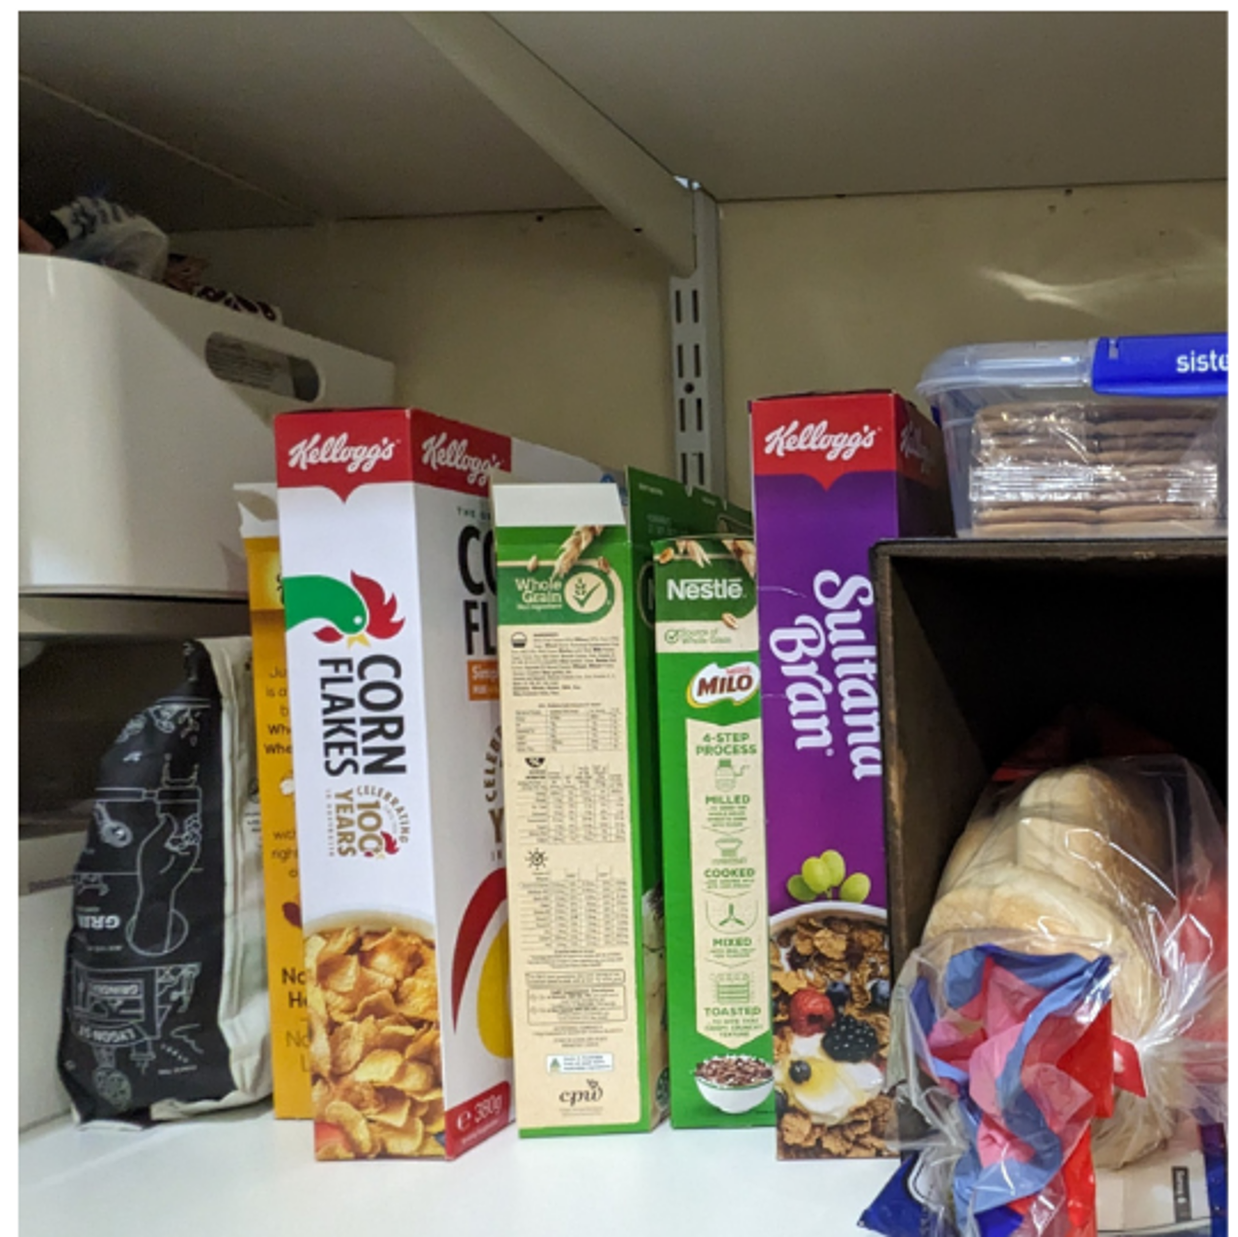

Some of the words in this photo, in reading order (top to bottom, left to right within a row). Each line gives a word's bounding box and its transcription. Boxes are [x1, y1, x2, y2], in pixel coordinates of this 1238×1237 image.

[764, 419, 875, 461] Kellogg's
[288, 432, 396, 473] Kellogg's
[515, 578, 562, 592] Whole
[521, 589, 562, 604] Grain
[696, 674, 754, 697] MILO
[768, 614, 834, 751] Bran
[318, 657, 359, 777] FLAKES
[356, 654, 407, 776] CORN
[696, 744, 757, 756] PROCESS
[705, 794, 751, 805] MILLED
[334, 788, 357, 858] YEARS
[703, 868, 757, 879] COOKED
[711, 937, 753, 948] MIXED
[703, 1007, 762, 1018] TOASTED
